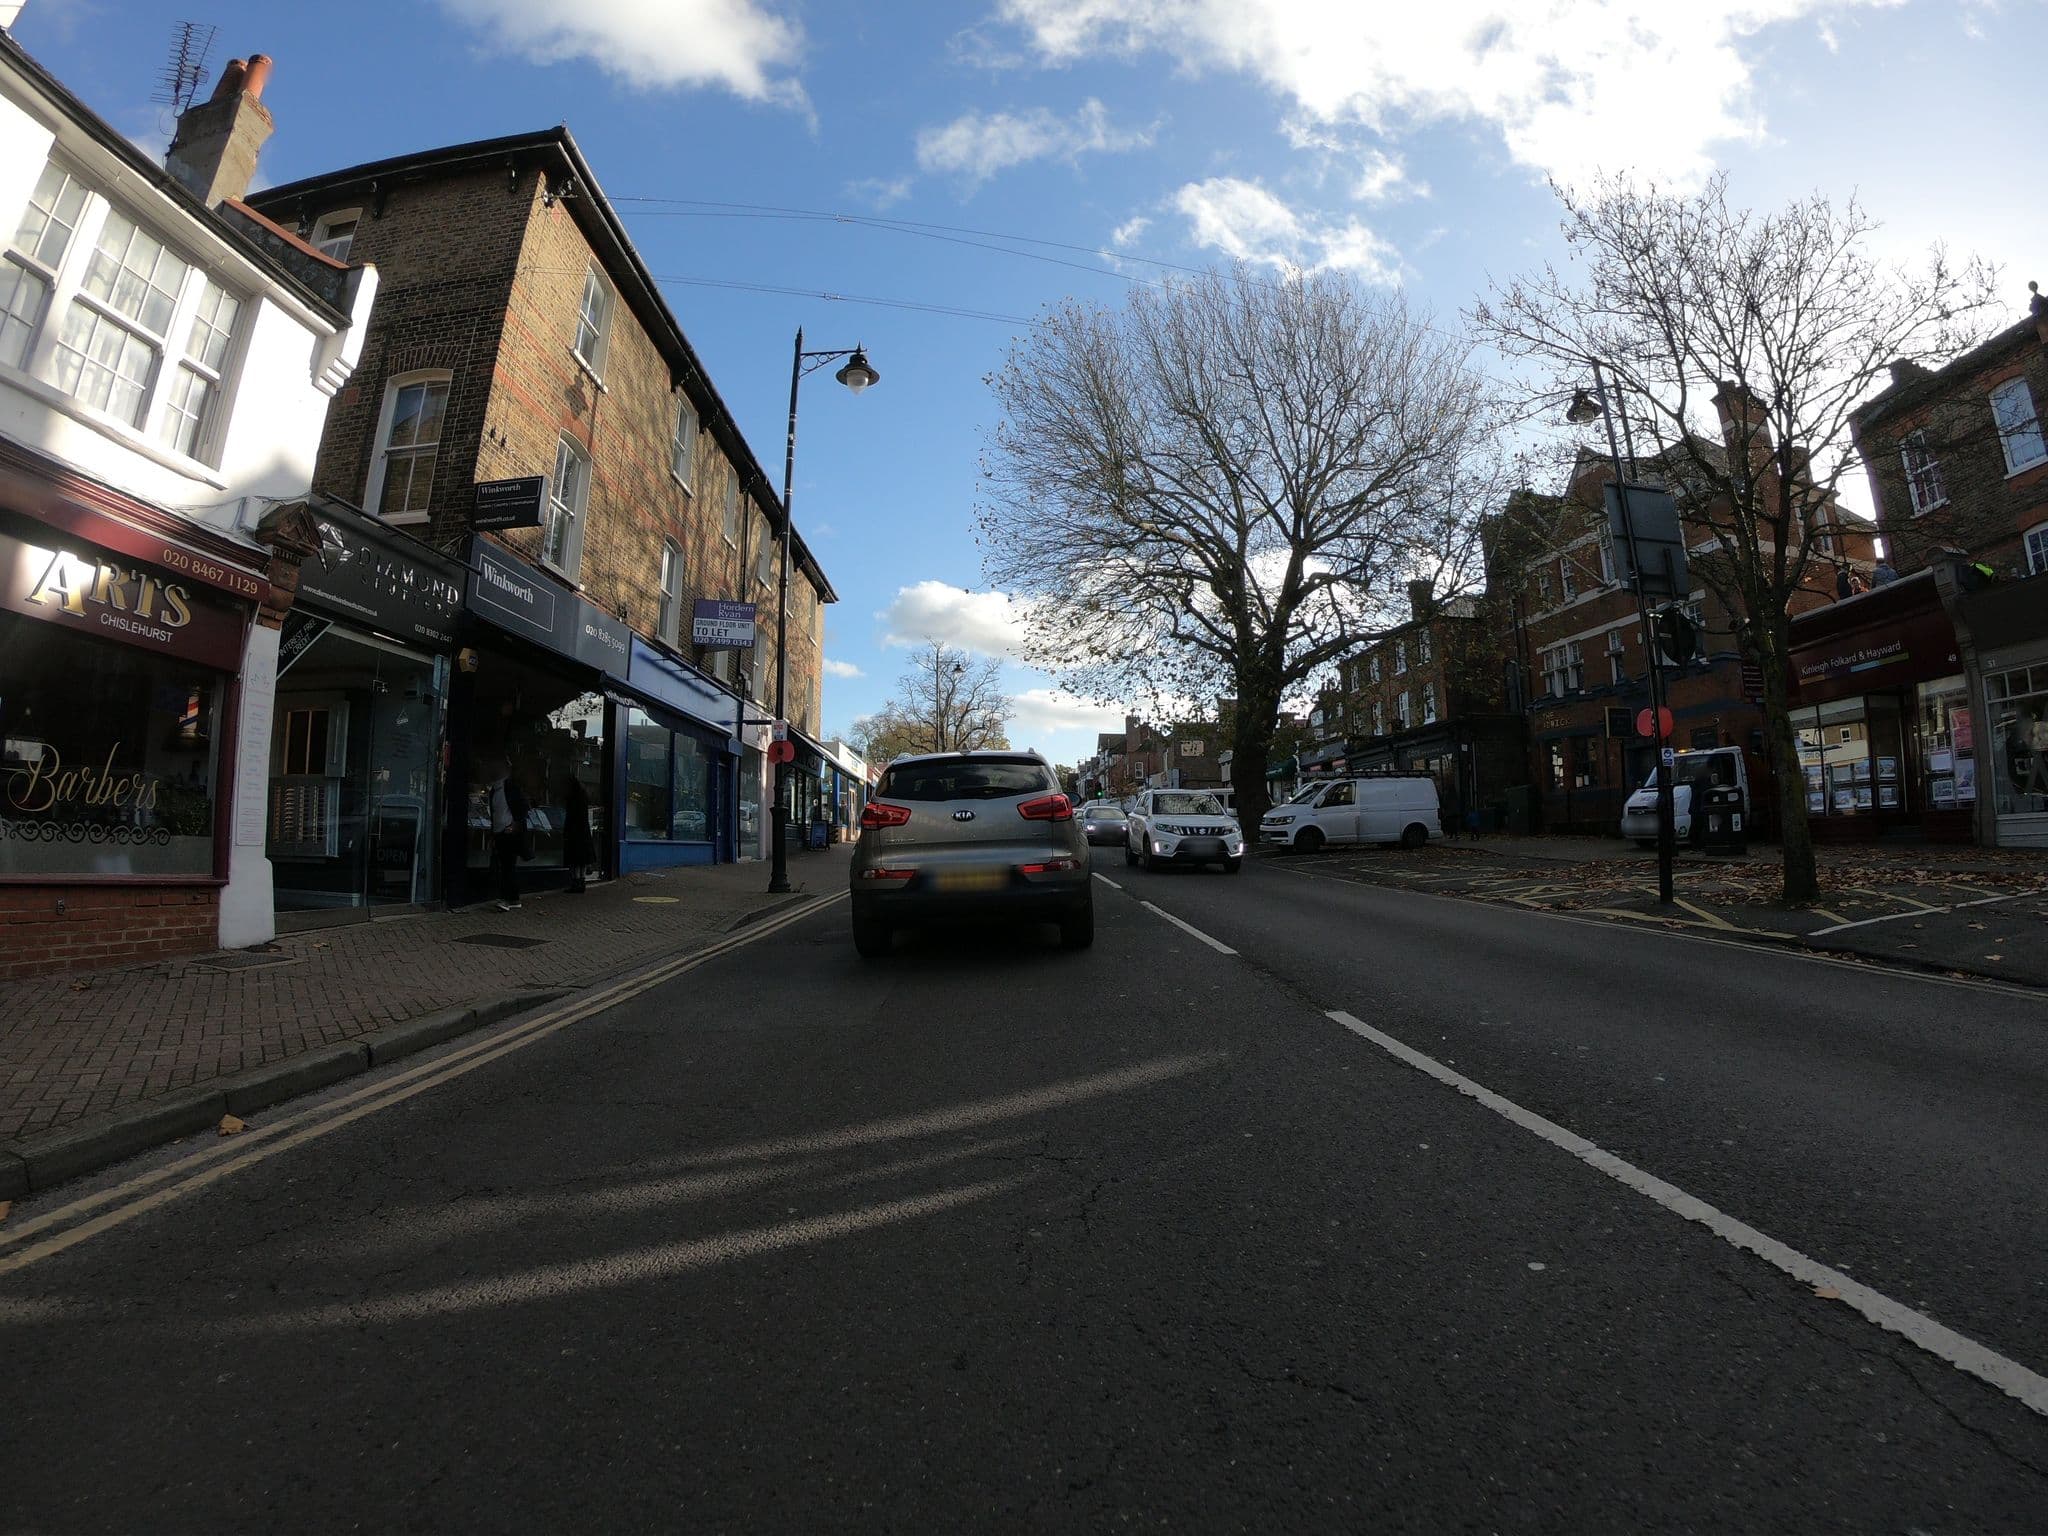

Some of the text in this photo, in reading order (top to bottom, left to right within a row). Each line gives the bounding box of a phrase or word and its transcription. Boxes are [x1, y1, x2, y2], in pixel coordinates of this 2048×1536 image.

[481, 483, 520, 494] Winkworth
[163, 549, 258, 595] 020 8467 1129
[358, 546, 459, 605] DIAMOND
[483, 562, 534, 604] Winkworth
[718, 610, 741, 618] Ryan
[100, 612, 173, 643] CHISLEHURST
[585, 624, 597, 637] 020
[695, 627, 729, 637] TO LET
[1800, 641, 1901, 677] Kinleigh Folkard & Hayward
[1947, 653, 1957, 662] 49
[8, 741, 160, 812] Barbers
[955, 811, 972, 819] KIA
